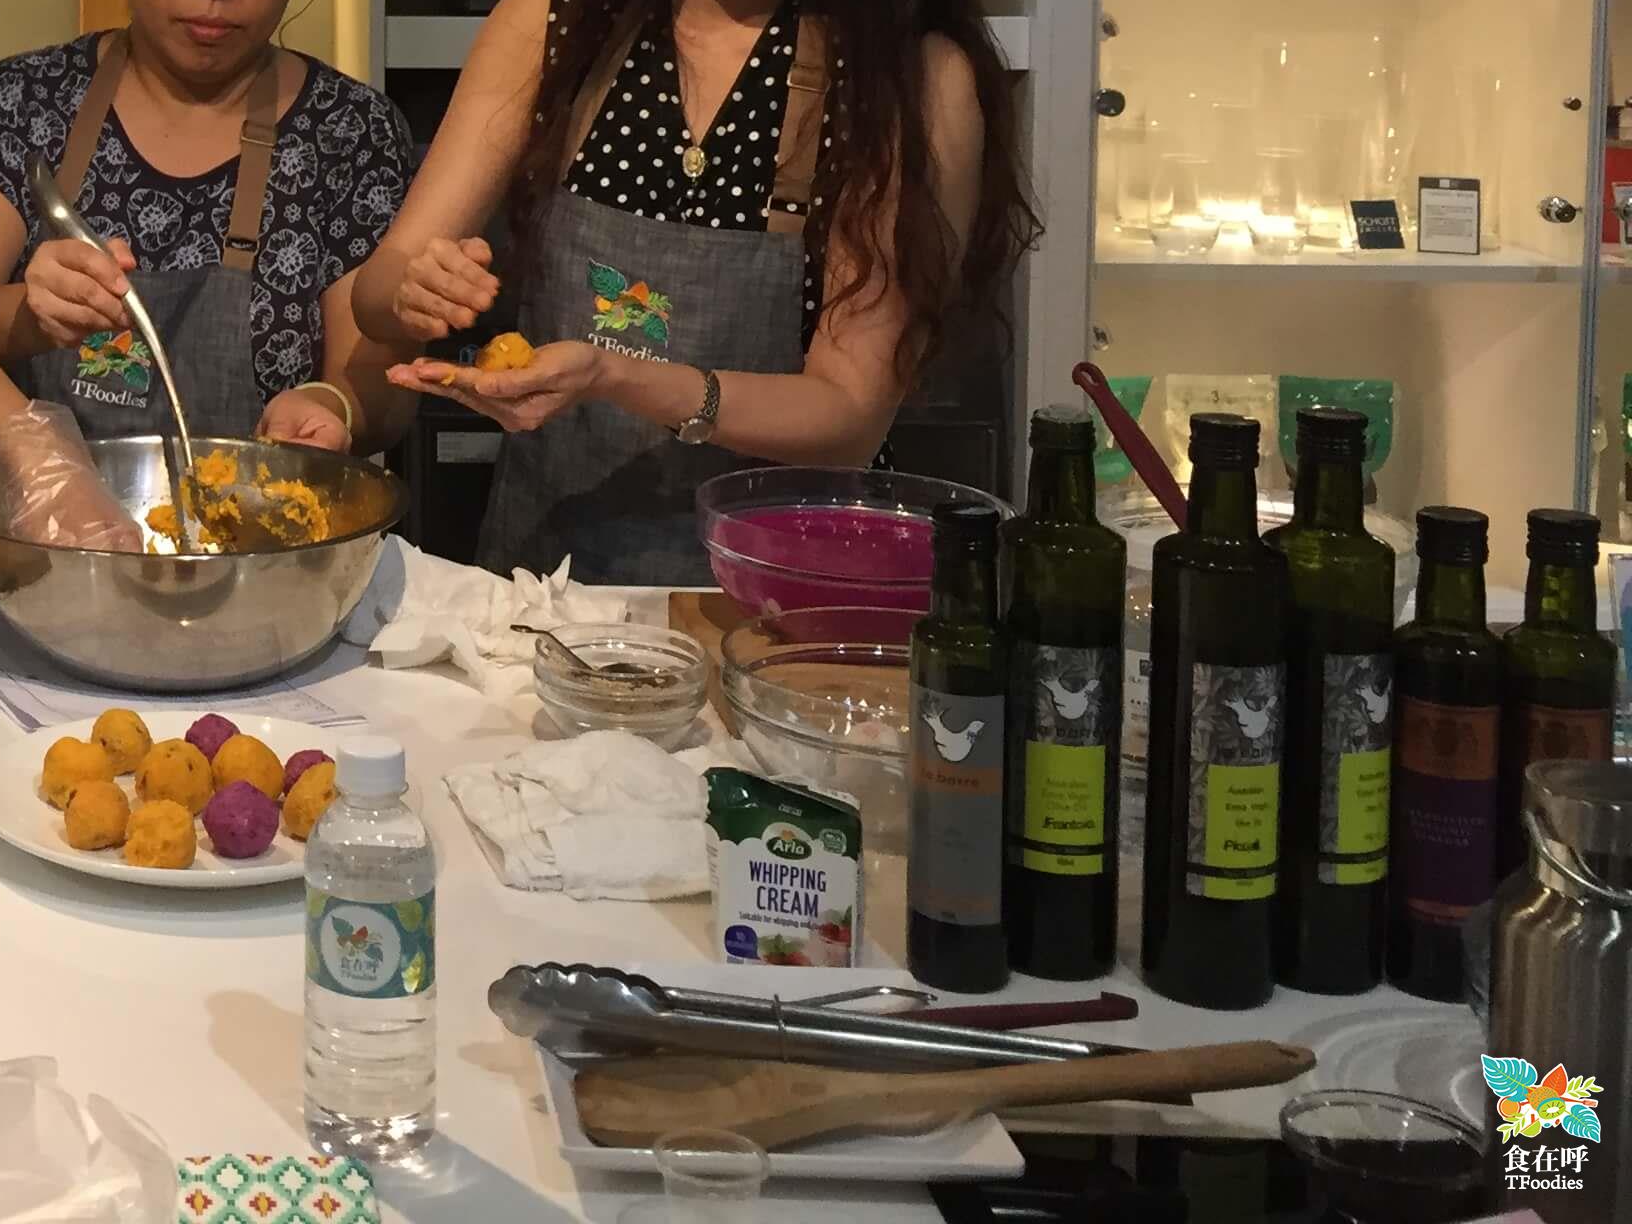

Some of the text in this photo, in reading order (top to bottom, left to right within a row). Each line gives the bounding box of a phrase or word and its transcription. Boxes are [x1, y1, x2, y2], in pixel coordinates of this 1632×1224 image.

[71, 378, 147, 408] TFoodies
[772, 839, 806, 856] Arla
[749, 860, 827, 892] WHIPPING
[756, 885, 818, 918] CREAM
